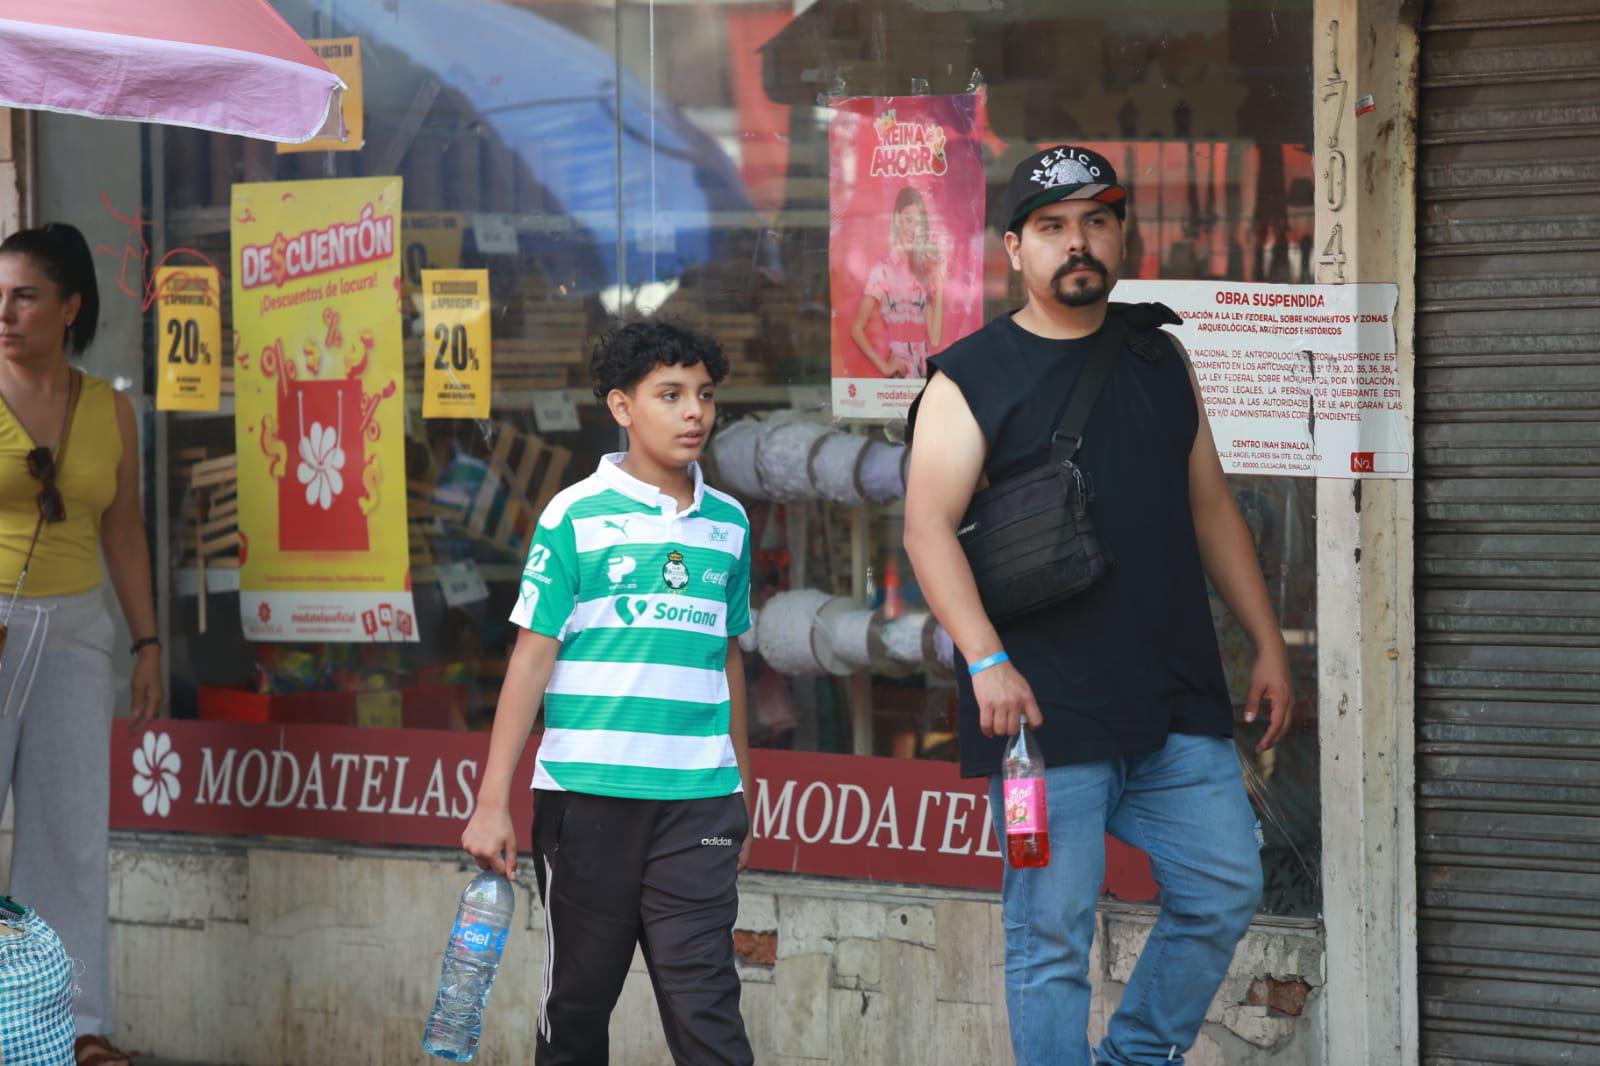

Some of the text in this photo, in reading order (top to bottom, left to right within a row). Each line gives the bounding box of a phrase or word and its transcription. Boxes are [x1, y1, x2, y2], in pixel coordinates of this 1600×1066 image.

[1030, 149, 1100, 182] MEXICO
[326, 280, 337, 298] de
[340, 272, 377, 295] locura!
[1216, 291, 1324, 307] OBRA SUSPENDIDA
[1222, 312, 1230, 320] LA
[1232, 312, 1243, 320] LEY
[1280, 315, 1302, 323] SOBRE
[1352, 315, 1359, 323] Y
[1361, 314, 1388, 323] ZONAS
[1305, 326, 1342, 335] HISTÓRICOS
[1195, 349, 1229, 357] NACIONAL
[1232, 350, 1242, 358] DE
[1337, 352, 1380, 361] SUSPENDE
[1192, 361, 1231, 369] NDAMENTO
[1199, 373, 1207, 381] LA
[1210, 373, 1222, 381] LEY
[1225, 374, 1253, 382] FEDERAL
[1258, 374, 1280, 382] SOBRE
[1331, 376, 1347, 385] POR
[1351, 376, 1394, 385] VIOLACIÓN
[1314, 388, 1328, 397] QUE
[1331, 389, 1378, 397] QUEBRANTE
[1263, 398, 1308, 408] AUTORIDADES
[1318, 400, 1326, 408] SE
[1388, 402, 1402, 410] LAS
[1230, 409, 1290, 418] ADMINISTRATIVAS
[1232, 440, 1310, 450] CENTRO INAH SINALOA
[654, 602, 717, 627] Soriana
[194, 747, 477, 820] MODATELAS
[753, 778, 1003, 857] MODATEL
[702, 837, 732, 845] adidas
[464, 930, 491, 947] ciel
